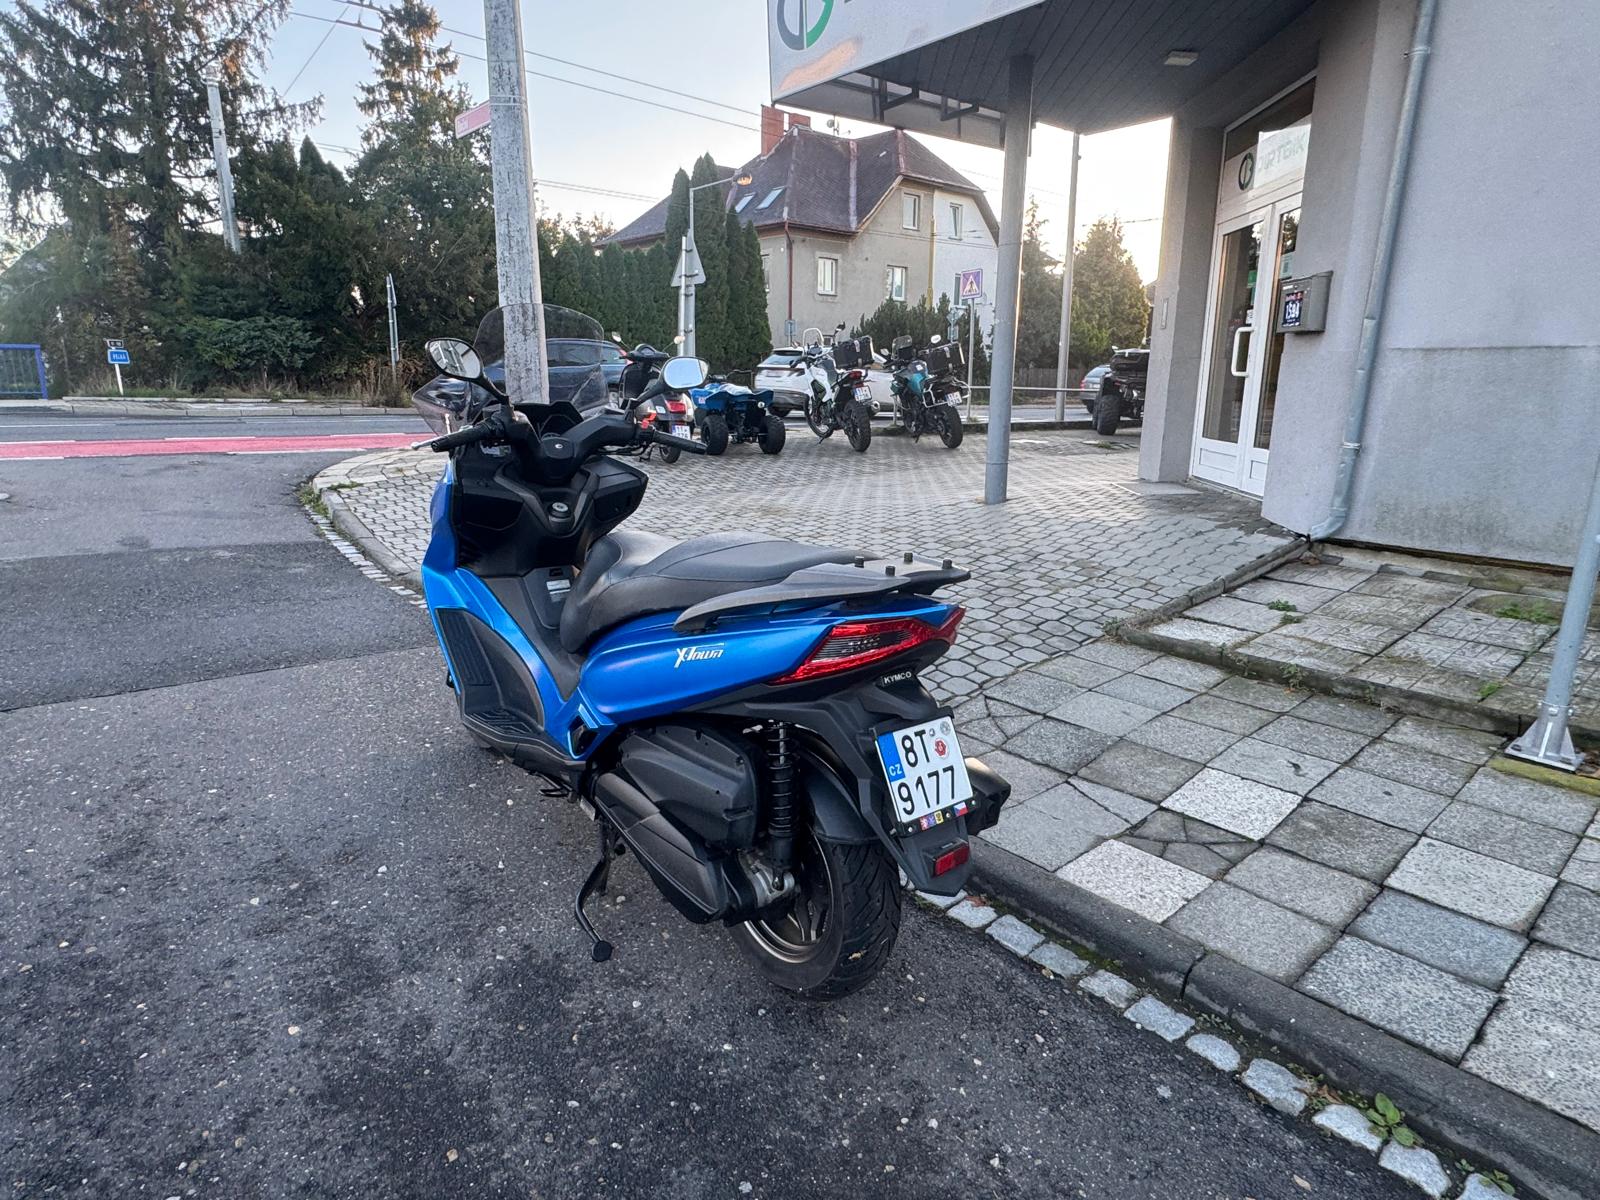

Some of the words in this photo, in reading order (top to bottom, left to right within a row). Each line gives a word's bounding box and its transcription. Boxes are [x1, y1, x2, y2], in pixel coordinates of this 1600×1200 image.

[883, 671, 912, 684] KYMCO
[901, 729, 930, 768] 8T
[888, 764, 902, 777] CZ
[897, 765, 955, 815] 9177
